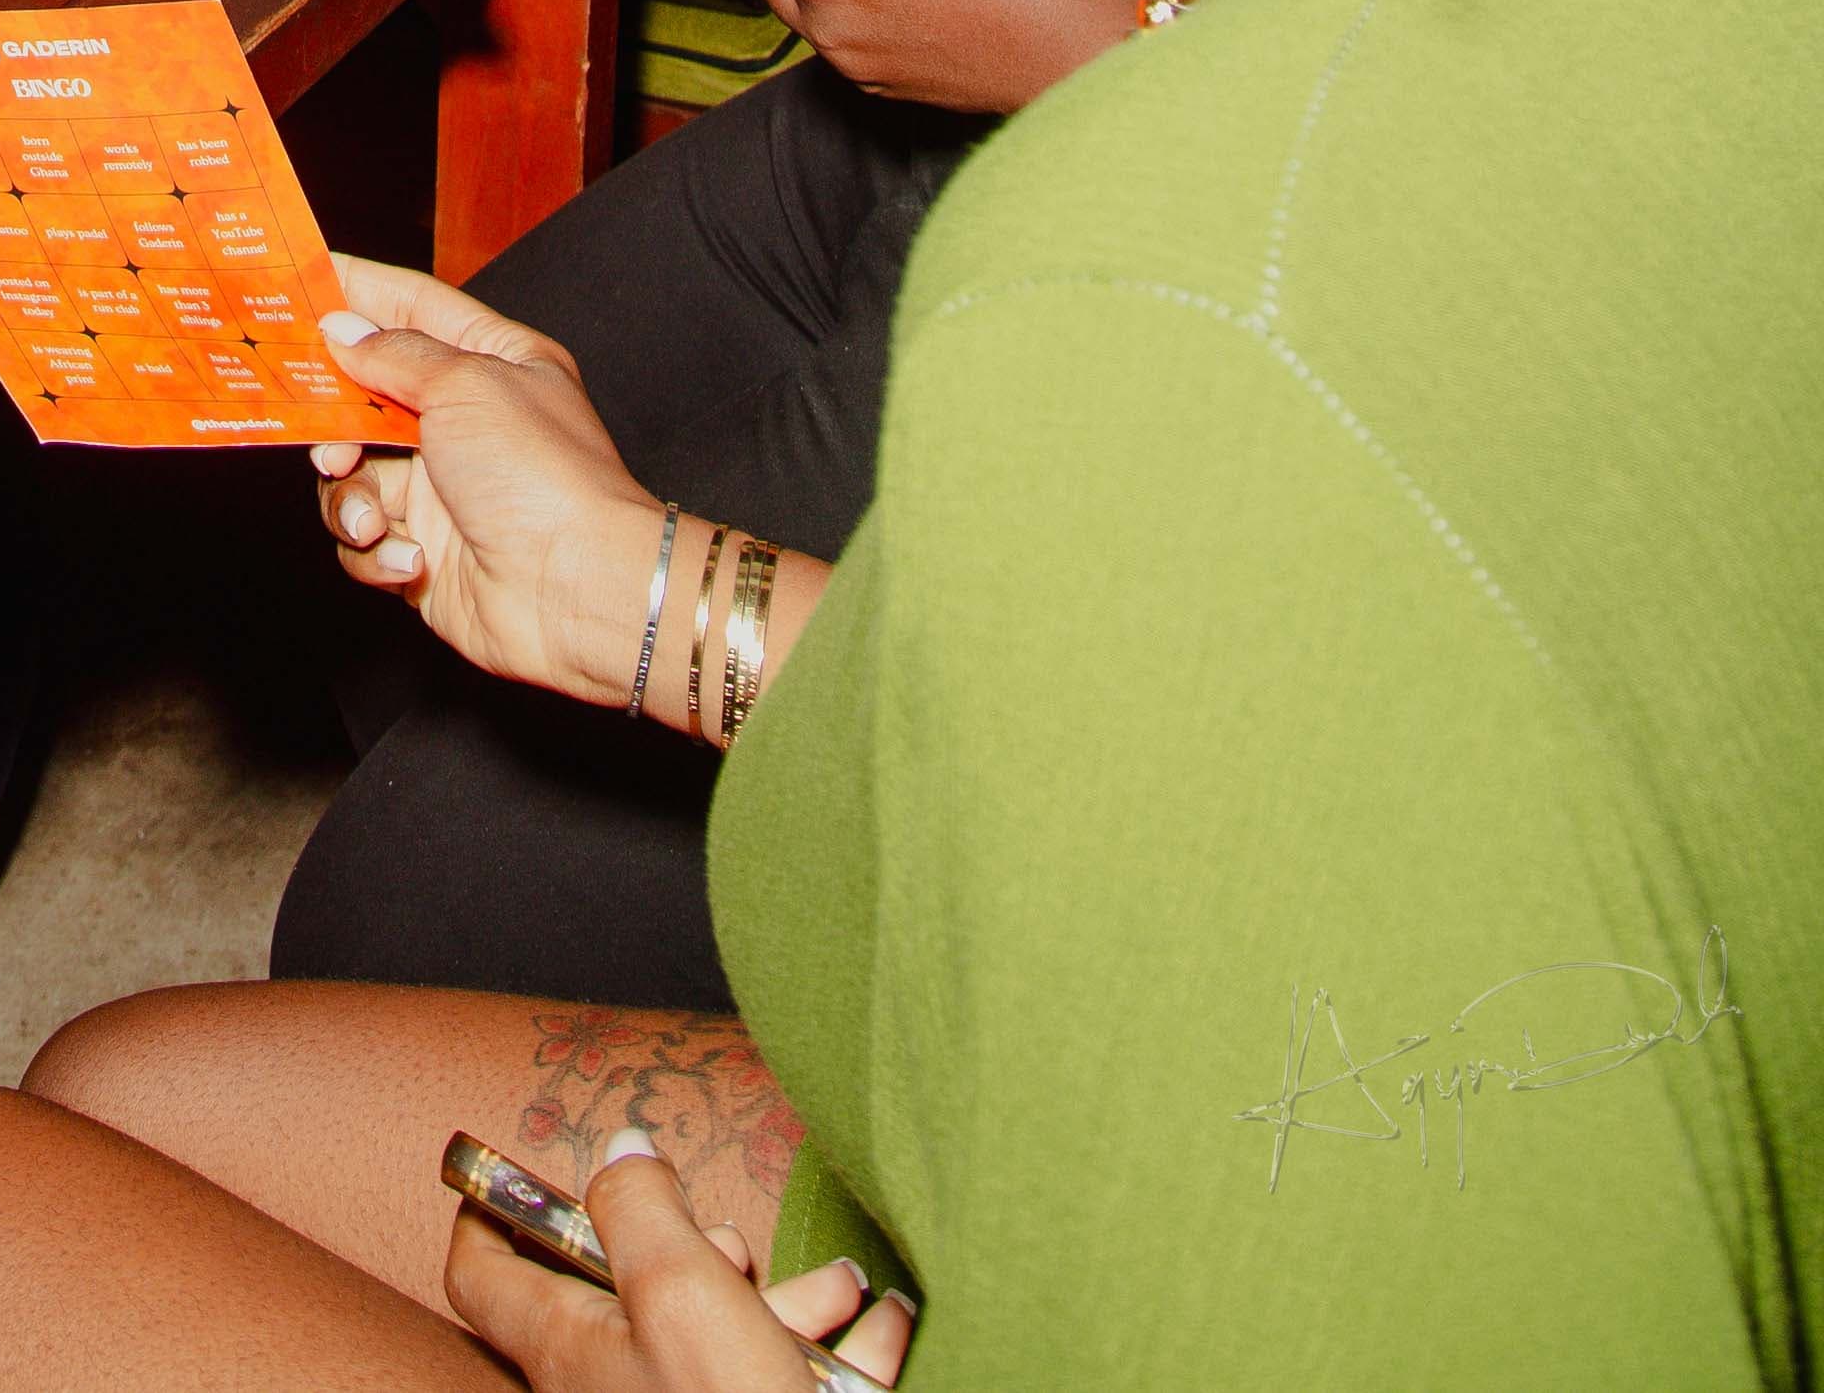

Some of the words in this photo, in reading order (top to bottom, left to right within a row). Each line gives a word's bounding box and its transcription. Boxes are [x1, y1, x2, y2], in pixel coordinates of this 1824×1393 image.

[2, 38, 111, 58] GADERIN
[11, 78, 92, 99] BINGO
[21, 135, 51, 147] born
[176, 140, 198, 152] has
[199, 138, 229, 150] been
[103, 143, 139, 155] works
[22, 150, 64, 163] outside
[189, 154, 230, 168] robbed
[103, 159, 153, 173] remotely
[29, 166, 69, 179] Ghana
[215, 211, 238, 222] has
[239, 212, 248, 222] a
[133, 221, 175, 233] follows
[211, 225, 265, 241] YouTube
[45, 227, 76, 240] plays
[77, 228, 109, 240] padel
[138, 238, 185, 250] Gaderin
[221, 242, 268, 256] channel
[34, 279, 51, 289] on
[78, 288, 89, 299] is
[90, 289, 114, 301] part
[115, 289, 129, 301] of
[156, 284, 179, 296] has
[180, 287, 211, 297] more
[0, 290, 61, 305] Instagram
[242, 294, 255, 306] is
[256, 297, 264, 306] a
[264, 294, 290, 306] tech
[22, 306, 55, 318] today
[91, 304, 113, 314] run
[114, 304, 140, 315] club
[174, 300, 200, 312] than
[253, 309, 294, 322] bro/sis
[179, 315, 223, 329] siblings
[32, 344, 44, 355] is
[45, 346, 94, 359] wearing
[208, 352, 232, 364] has
[50, 359, 94, 371] African
[134, 363, 146, 373] is
[146, 363, 174, 374] bald
[283, 360, 311, 370] went
[311, 361, 326, 370] to
[215, 366, 256, 378] British
[291, 372, 313, 383] the
[314, 373, 338, 384] gym
[65, 375, 96, 387] print
[227, 380, 264, 391] accent
[309, 385, 341, 396] today
[191, 418, 286, 432] @thegaderin
